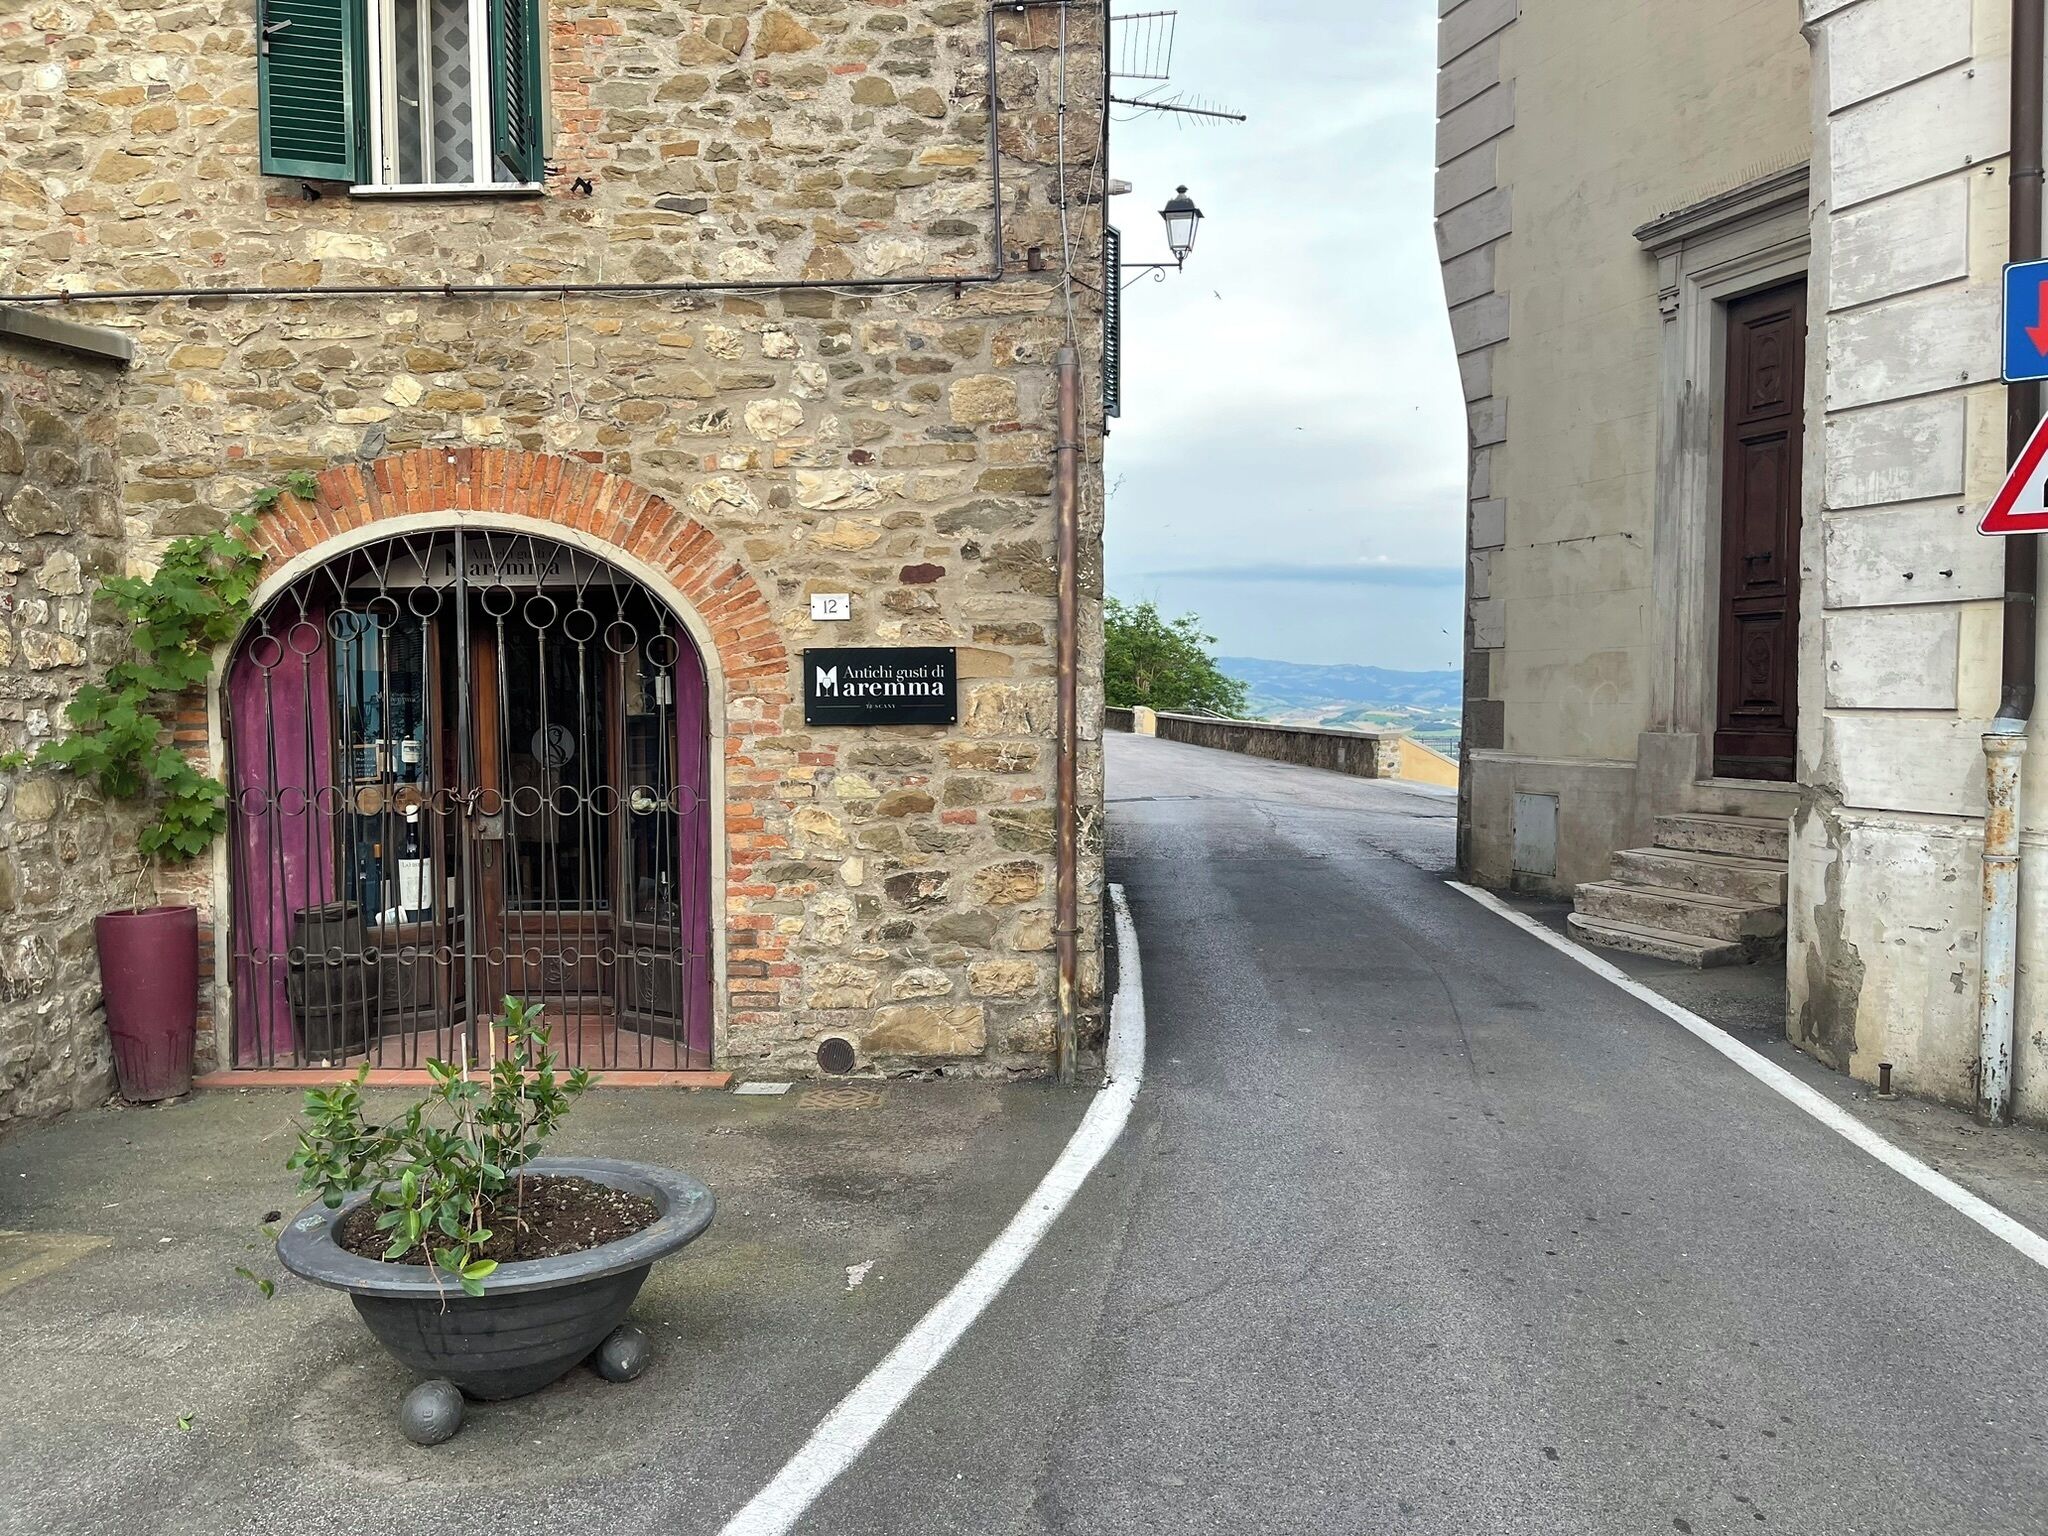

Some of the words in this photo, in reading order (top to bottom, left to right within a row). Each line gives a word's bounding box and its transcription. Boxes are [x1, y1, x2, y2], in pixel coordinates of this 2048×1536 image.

[823, 599, 837, 614] 12
[815, 665, 945, 697] Maremma
[843, 665, 892, 679] Antichi
[896, 665, 928, 682] gusti
[931, 664, 945, 678] di
